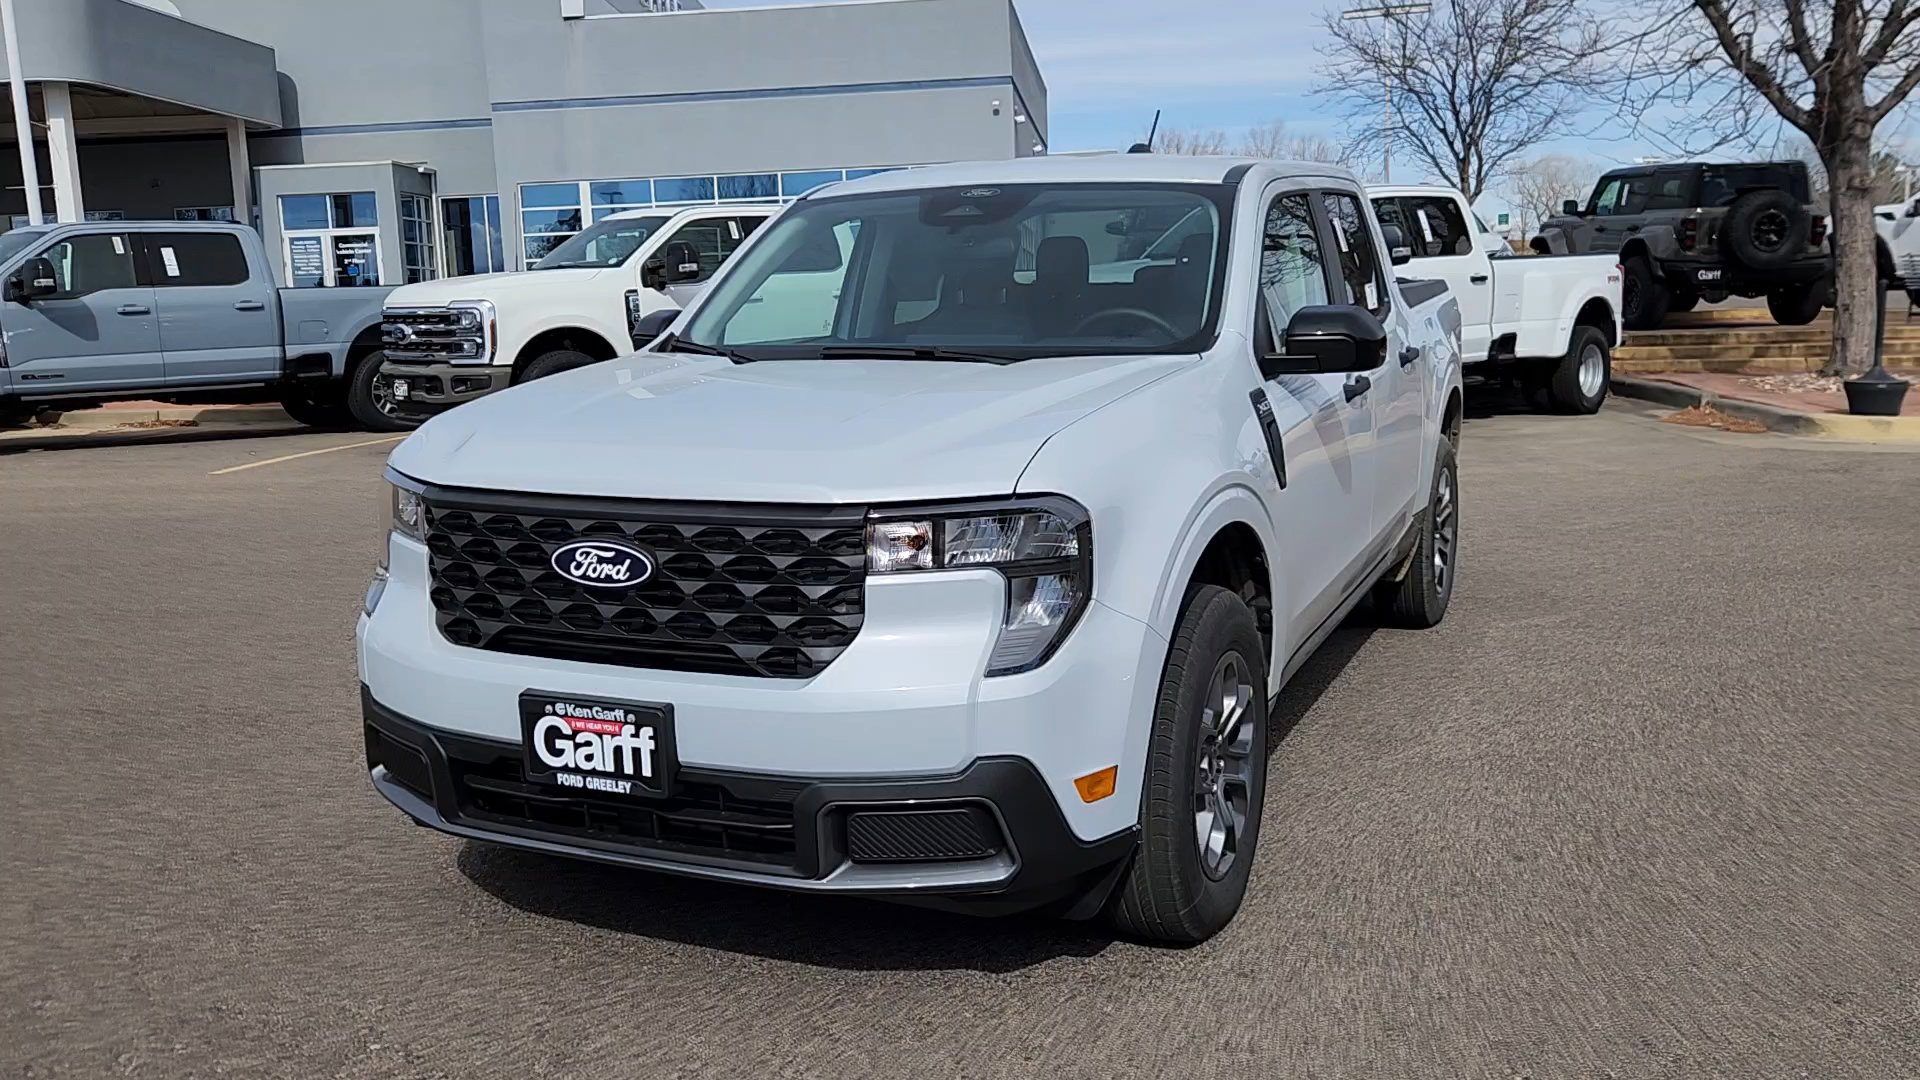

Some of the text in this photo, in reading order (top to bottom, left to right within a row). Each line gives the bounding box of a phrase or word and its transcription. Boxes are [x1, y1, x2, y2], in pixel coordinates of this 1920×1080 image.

[1697, 269, 1721, 280] Garff
[570, 547, 632, 581] Ford
[566, 703, 626, 722] Ken Garff
[575, 721, 615, 732] WE HEAR YOU
[533, 715, 656, 778] Garff
[556, 773, 632, 795] FORD GREELEY
